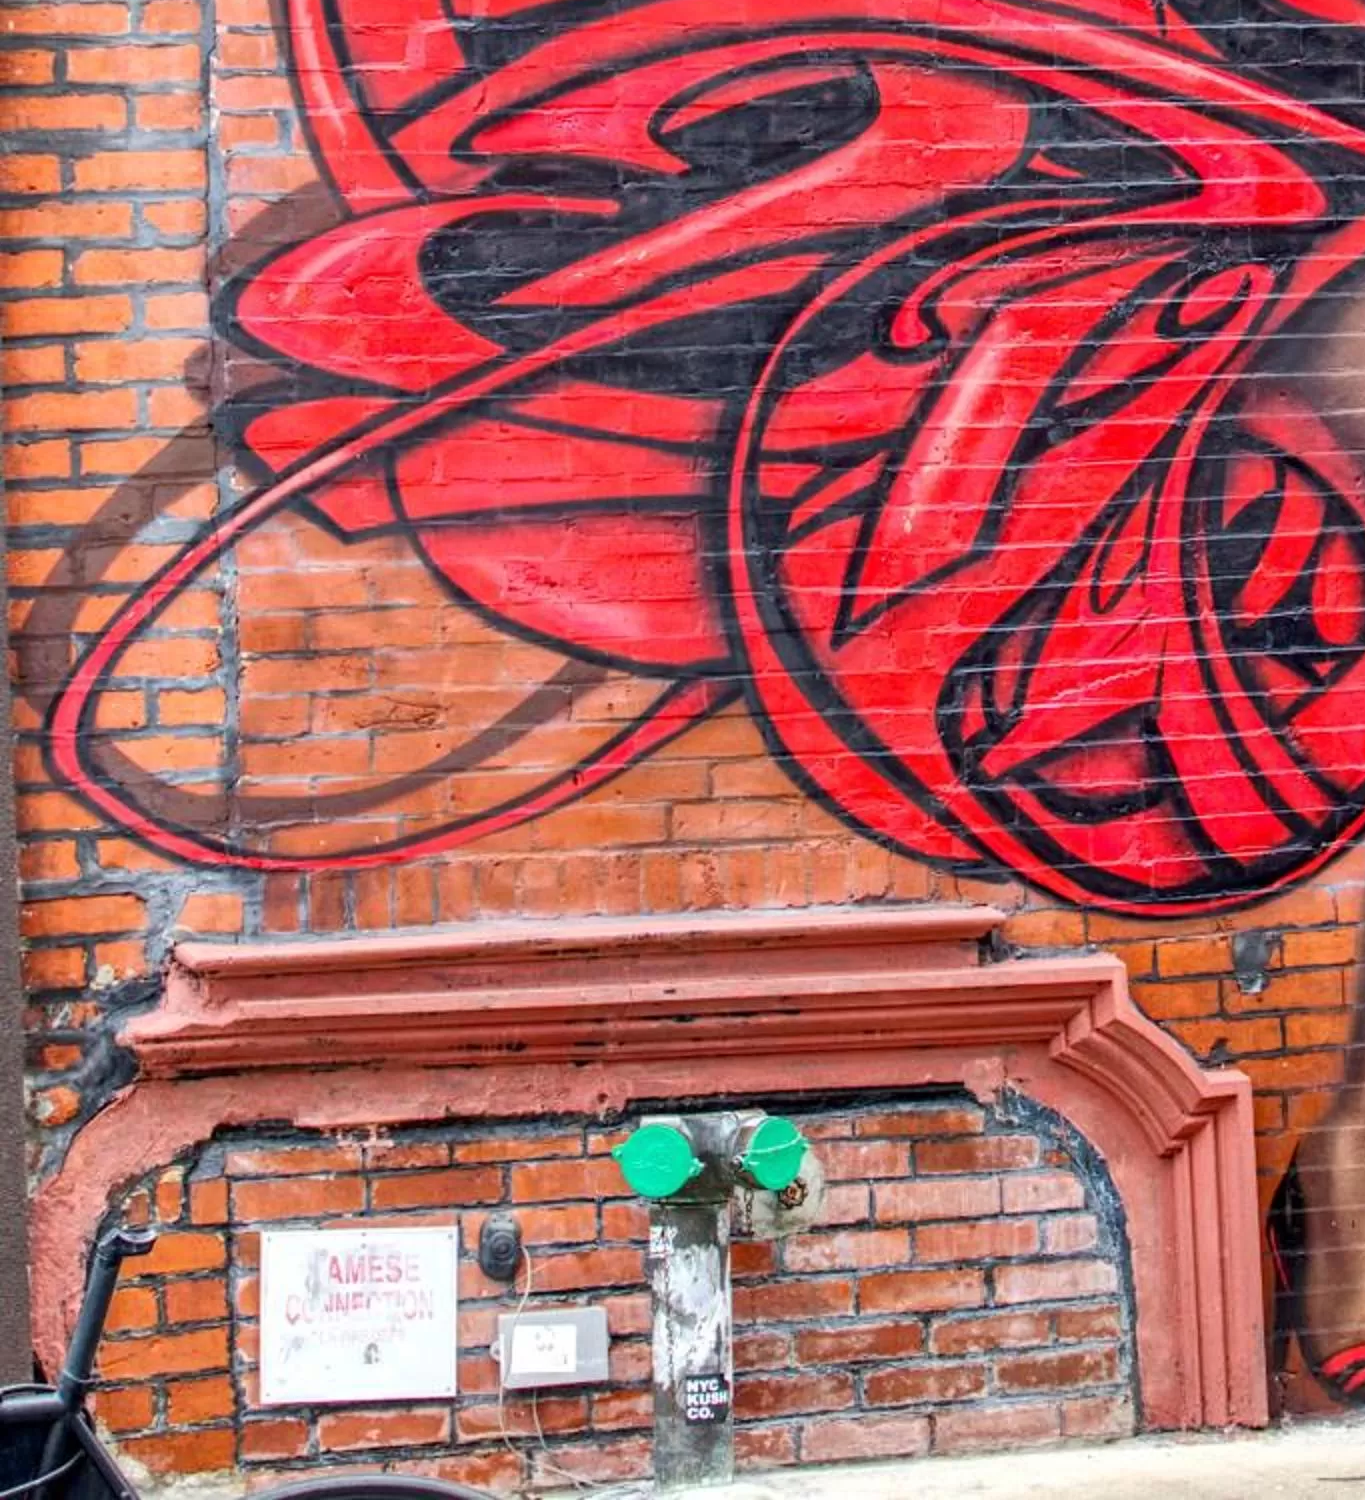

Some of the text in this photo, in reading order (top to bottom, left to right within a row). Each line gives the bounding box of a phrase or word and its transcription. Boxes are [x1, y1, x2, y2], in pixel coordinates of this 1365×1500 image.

[686, 1379, 719, 1392] NYC
[686, 1391, 728, 1407] KUSH
[686, 1407, 715, 1420] CO.
